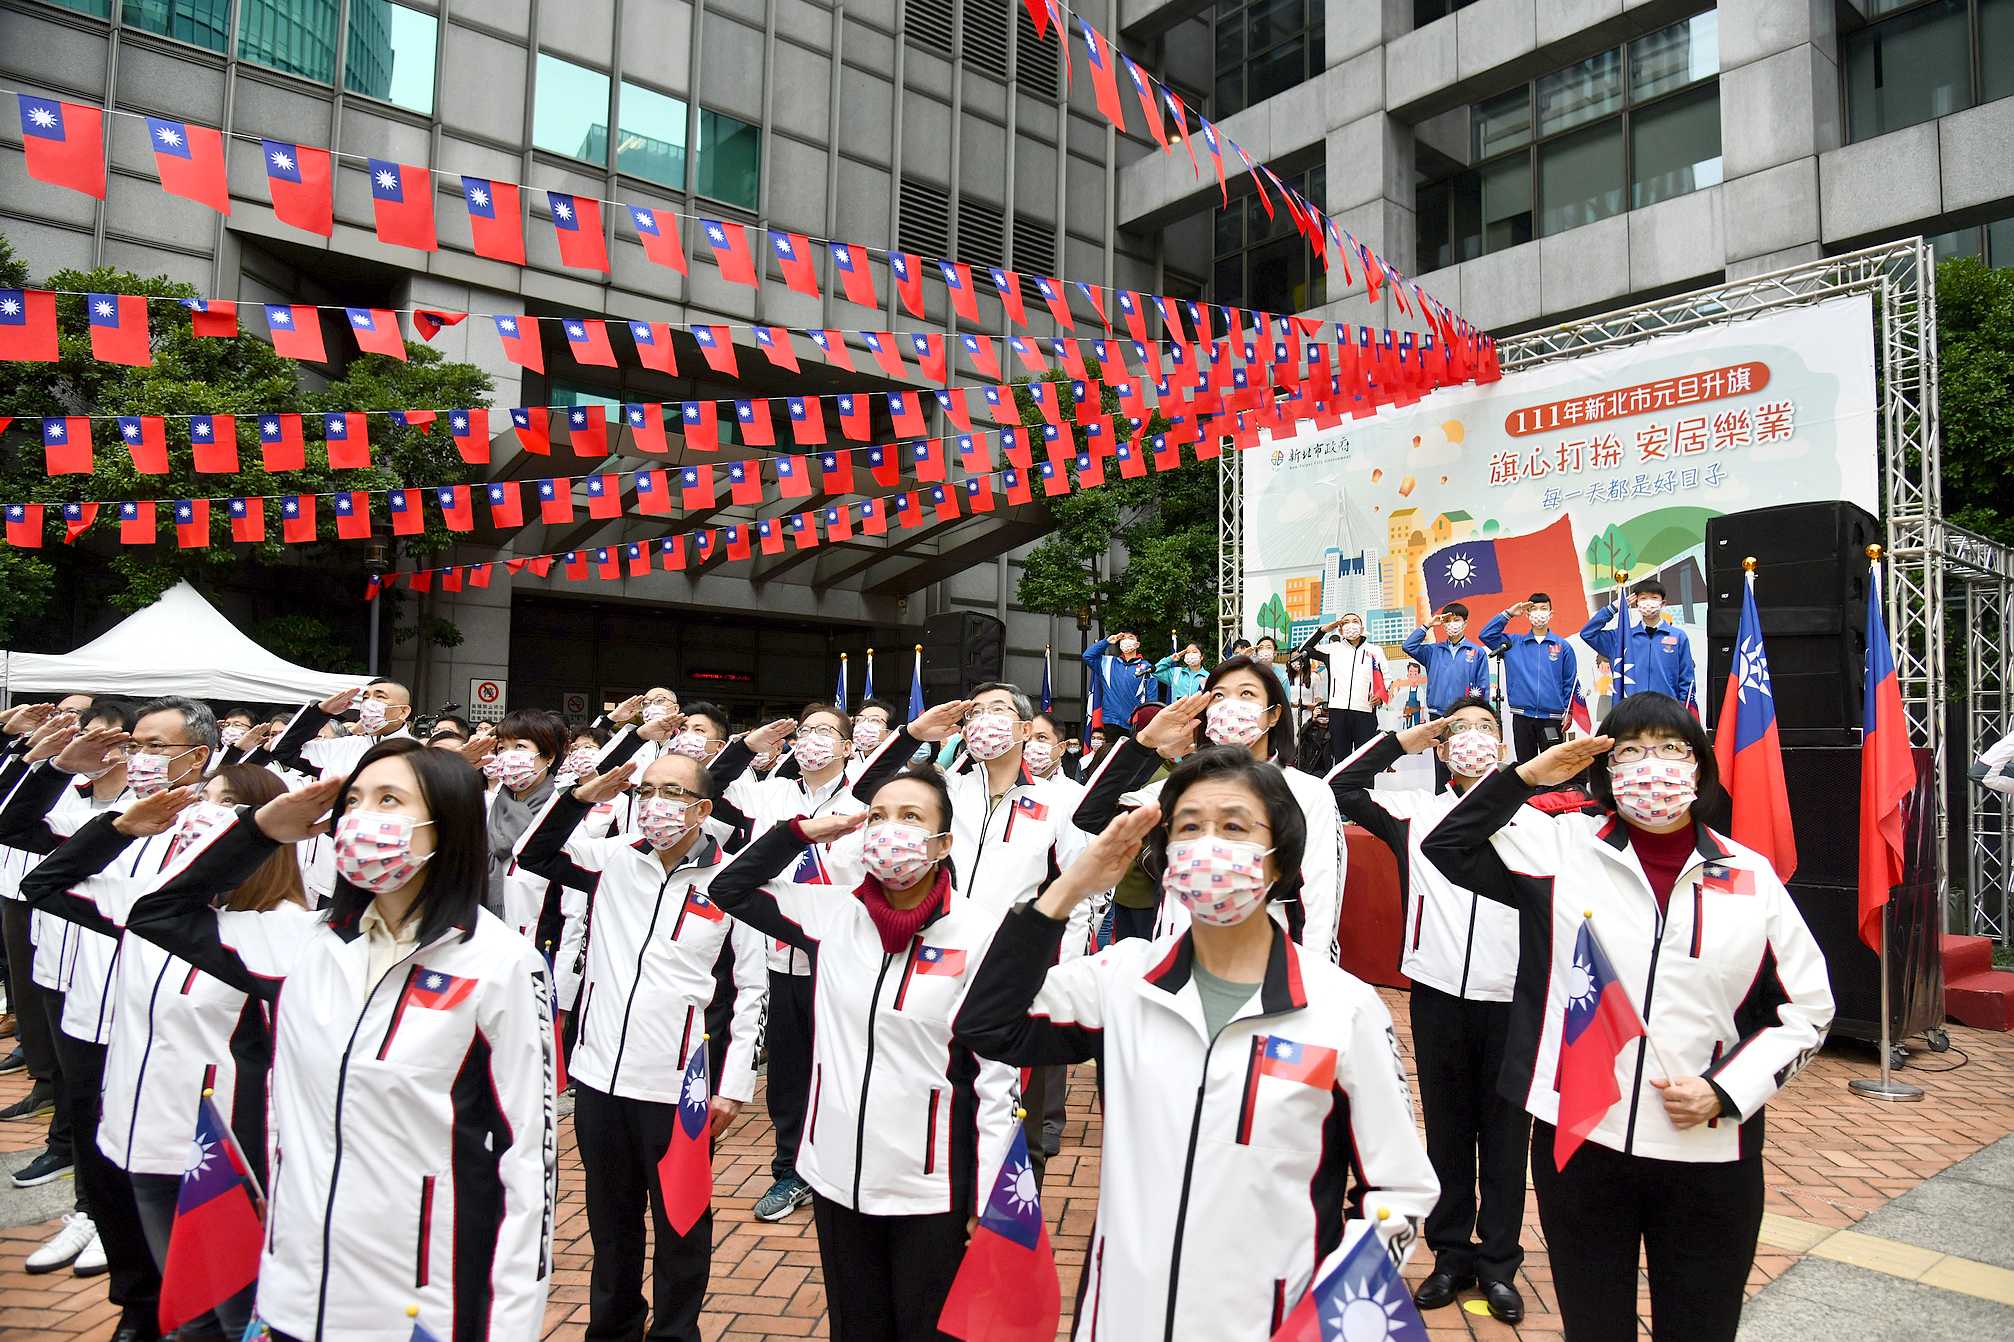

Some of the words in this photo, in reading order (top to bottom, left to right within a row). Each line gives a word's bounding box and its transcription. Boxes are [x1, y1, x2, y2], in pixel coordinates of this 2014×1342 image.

[1516, 367, 1752, 433] 111年新北市元旦升旗
[1288, 437, 1350, 463] 新北市政府
[1489, 433, 1623, 484] 旗心打拚
[1636, 399, 1795, 459] 安居樂業
[1542, 463, 1727, 508] 每一天都是好日子
